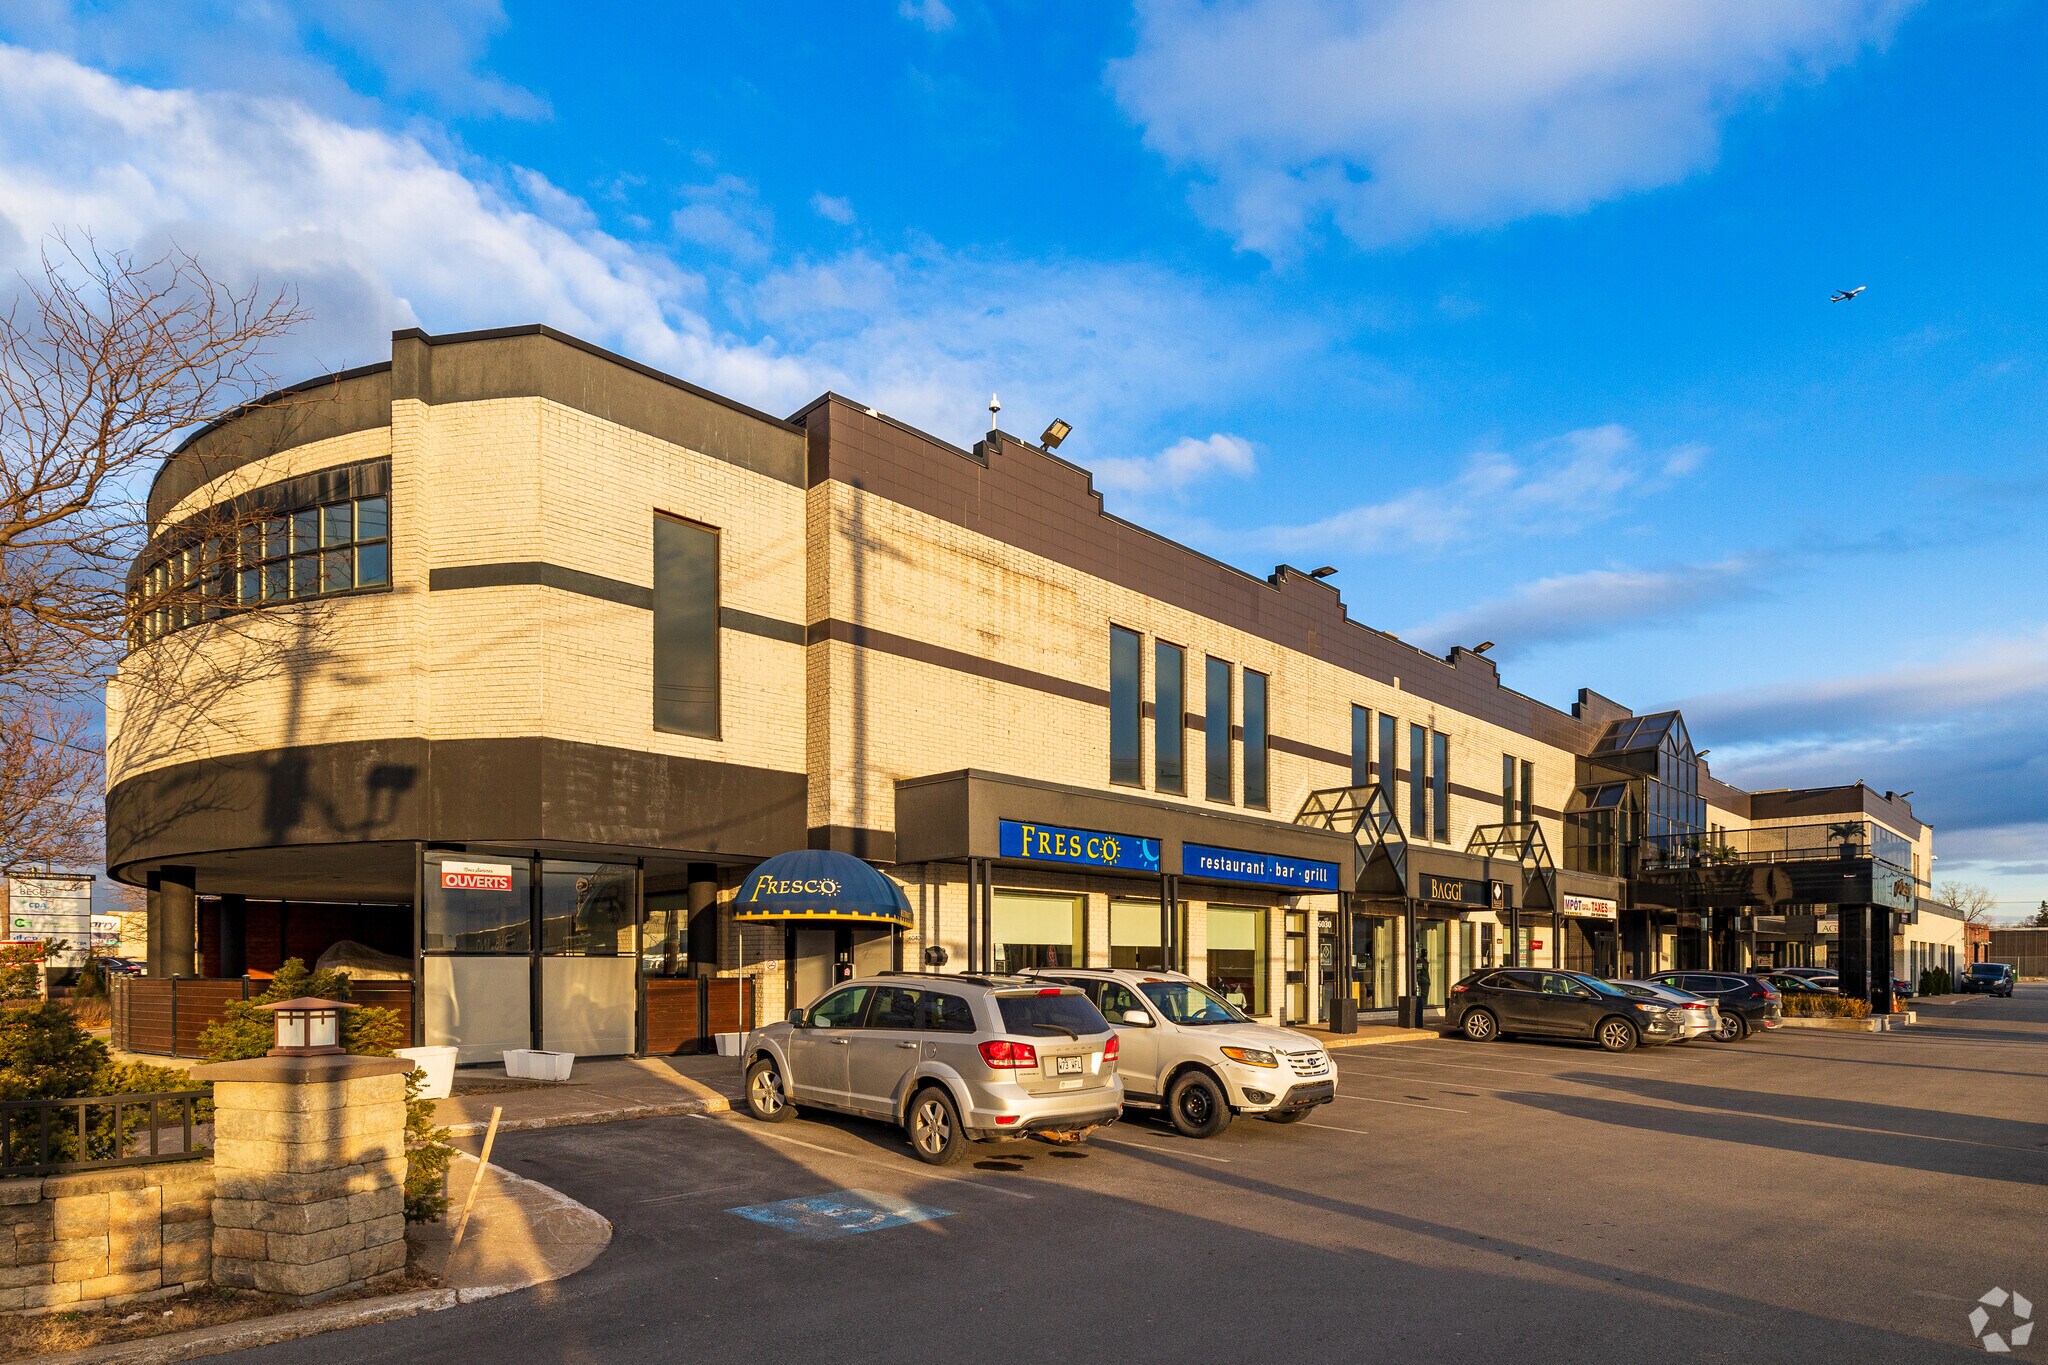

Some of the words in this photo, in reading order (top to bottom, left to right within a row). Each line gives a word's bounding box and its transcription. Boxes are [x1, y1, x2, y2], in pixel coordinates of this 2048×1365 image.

[1021, 825, 1117, 861] FRESCO
[1200, 856, 1265, 875] restaurant
[1275, 862, 1294, 878] bar
[1304, 868, 1327, 883] grill
[445, 874, 508, 889] OUVERTS
[750, 875, 838, 902] FRESCO
[1591, 901, 1609, 913] TAXES
[1317, 920, 1332, 929] 6030
[1821, 924, 1839, 933] AG
